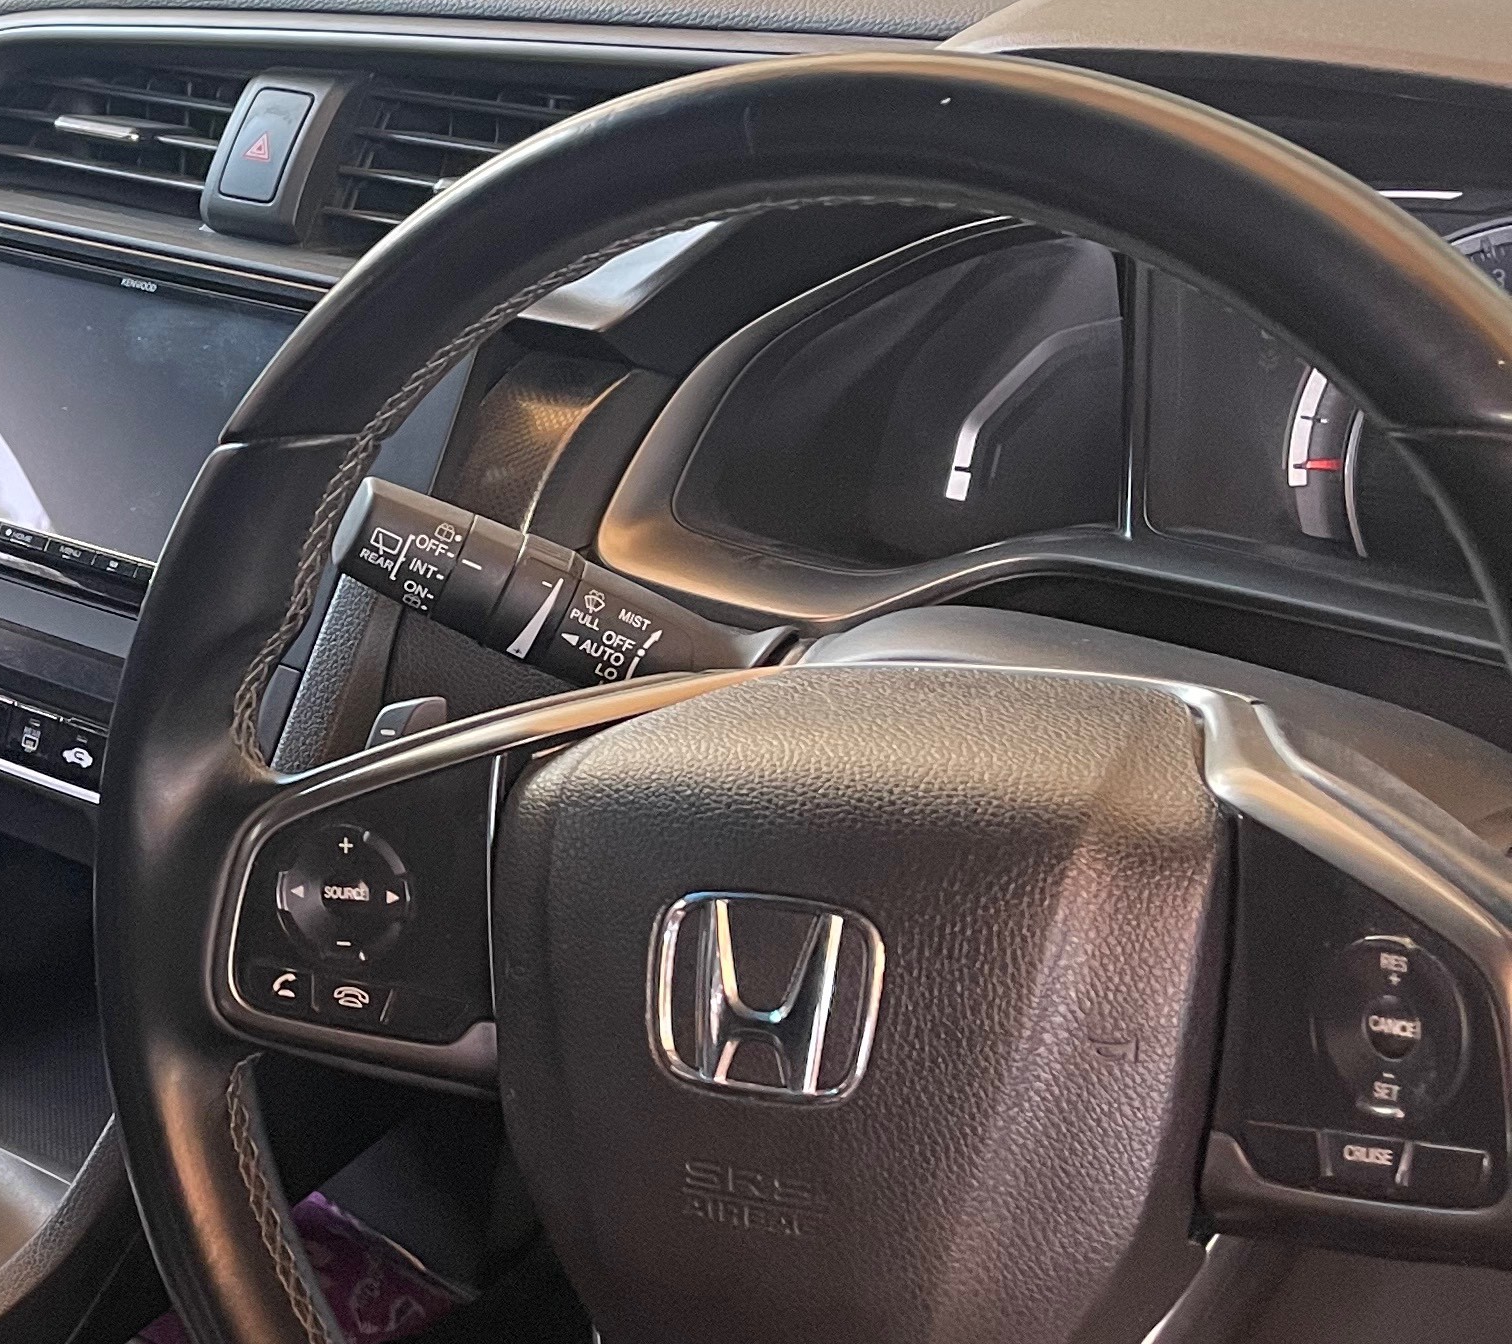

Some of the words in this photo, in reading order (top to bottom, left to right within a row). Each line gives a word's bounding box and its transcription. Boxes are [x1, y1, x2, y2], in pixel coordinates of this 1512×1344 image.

[121, 278, 157, 292] KENWOOD
[415, 534, 449, 556] OFF
[359, 548, 394, 571] REAR
[409, 558, 438, 578] INT
[403, 580, 429, 598] ON
[570, 608, 599, 631] PULL
[618, 608, 651, 630] MIST
[602, 630, 636, 652] OFF
[579, 639, 624, 666] AUTO
[594, 663, 618, 680] LO
[324, 885, 369, 901] SOURCE
[1373, 1081, 1401, 1101] SET
[1343, 1145, 1394, 1166] CRUISE
